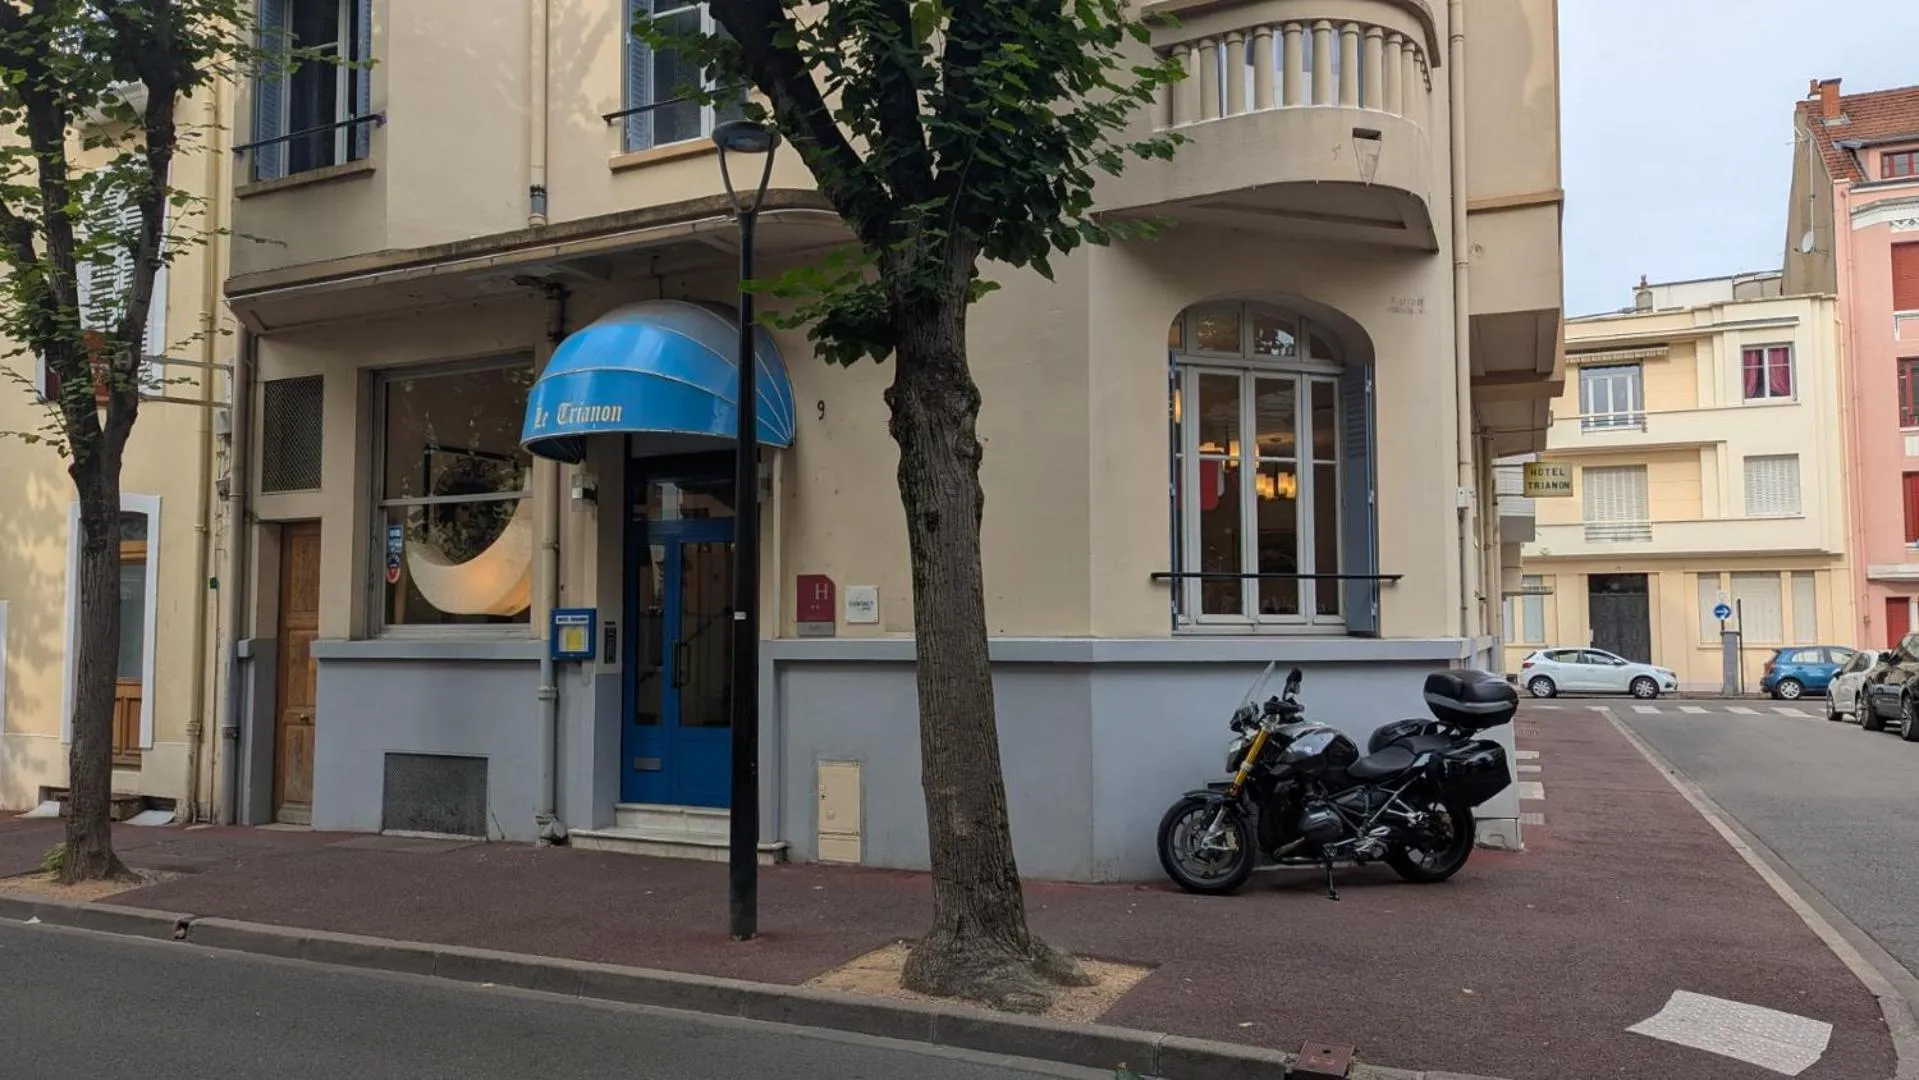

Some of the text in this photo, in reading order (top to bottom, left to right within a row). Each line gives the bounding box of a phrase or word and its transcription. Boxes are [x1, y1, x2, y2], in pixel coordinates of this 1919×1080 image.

[535, 402, 622, 428] Le Trianon
[817, 400, 825, 421] 9
[1530, 467, 1566, 477] HOTEL
[1528, 481, 1570, 490] TRIANON
[815, 583, 829, 600] H
